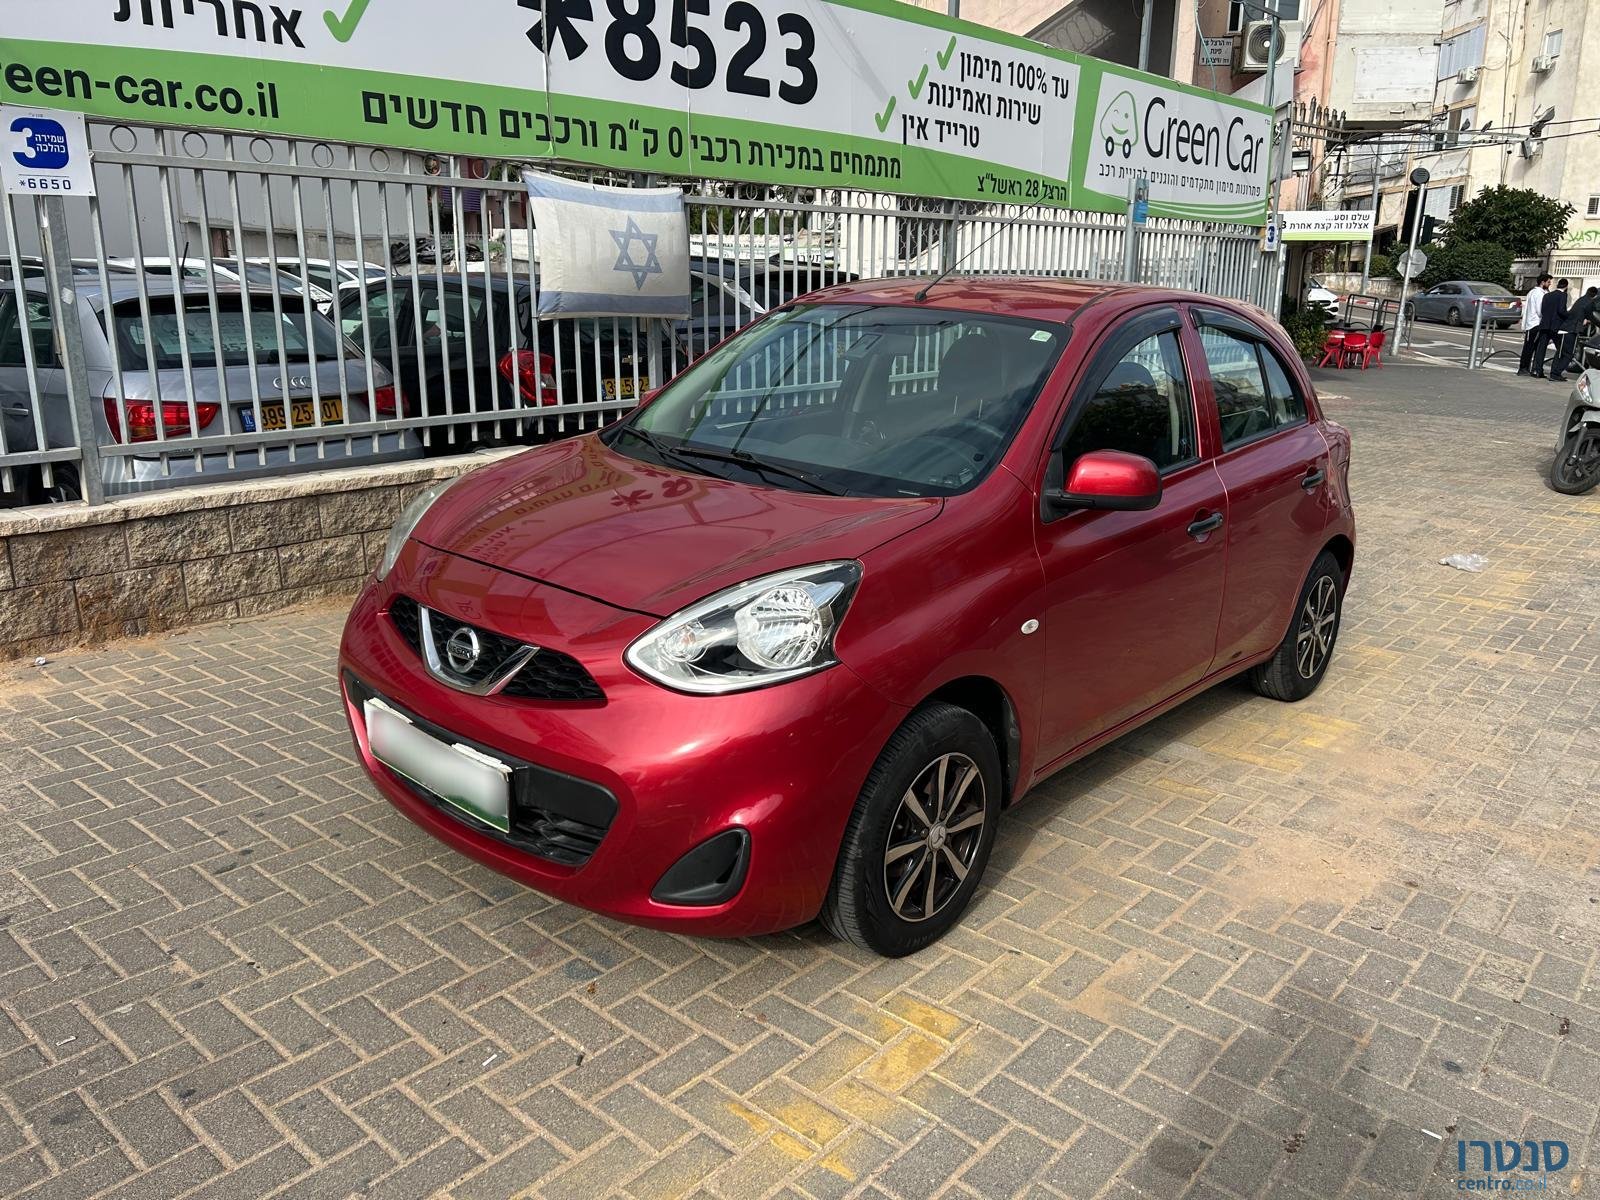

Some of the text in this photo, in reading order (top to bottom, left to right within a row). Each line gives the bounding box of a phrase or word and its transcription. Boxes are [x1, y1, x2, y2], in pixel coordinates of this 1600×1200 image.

[960, 52, 1069, 99] עד 100% מימון
[0, 62, 279, 119] een-car.co.il
[927, 81, 1041, 125] שירות ואמינות
[35, 133, 65, 143] שמירה
[361, 90, 901, 179] מתמחים במכירת רכבי 0 ק"מ ורכבים חדשים
[901, 114, 980, 148] טרייד אין
[1144, 96, 1264, 174] Green Car
[36, 143, 66, 153] כהלכה
[1099, 163, 1116, 178] רכב
[1150, 171, 1179, 186] והוגנים
[1180, 175, 1214, 193] מתקדמים
[977, 172, 1067, 201] הרצל 28 ראשל"צ
[1216, 180, 1234, 196] מימון
[1235, 183, 1261, 197] פתרונות
[1351, 213, 1370, 221] שלם
[1289, 222, 1312, 230] אחרת
[1314, 221, 1332, 231] קצת
[1345, 221, 1369, 229] אצלנו
